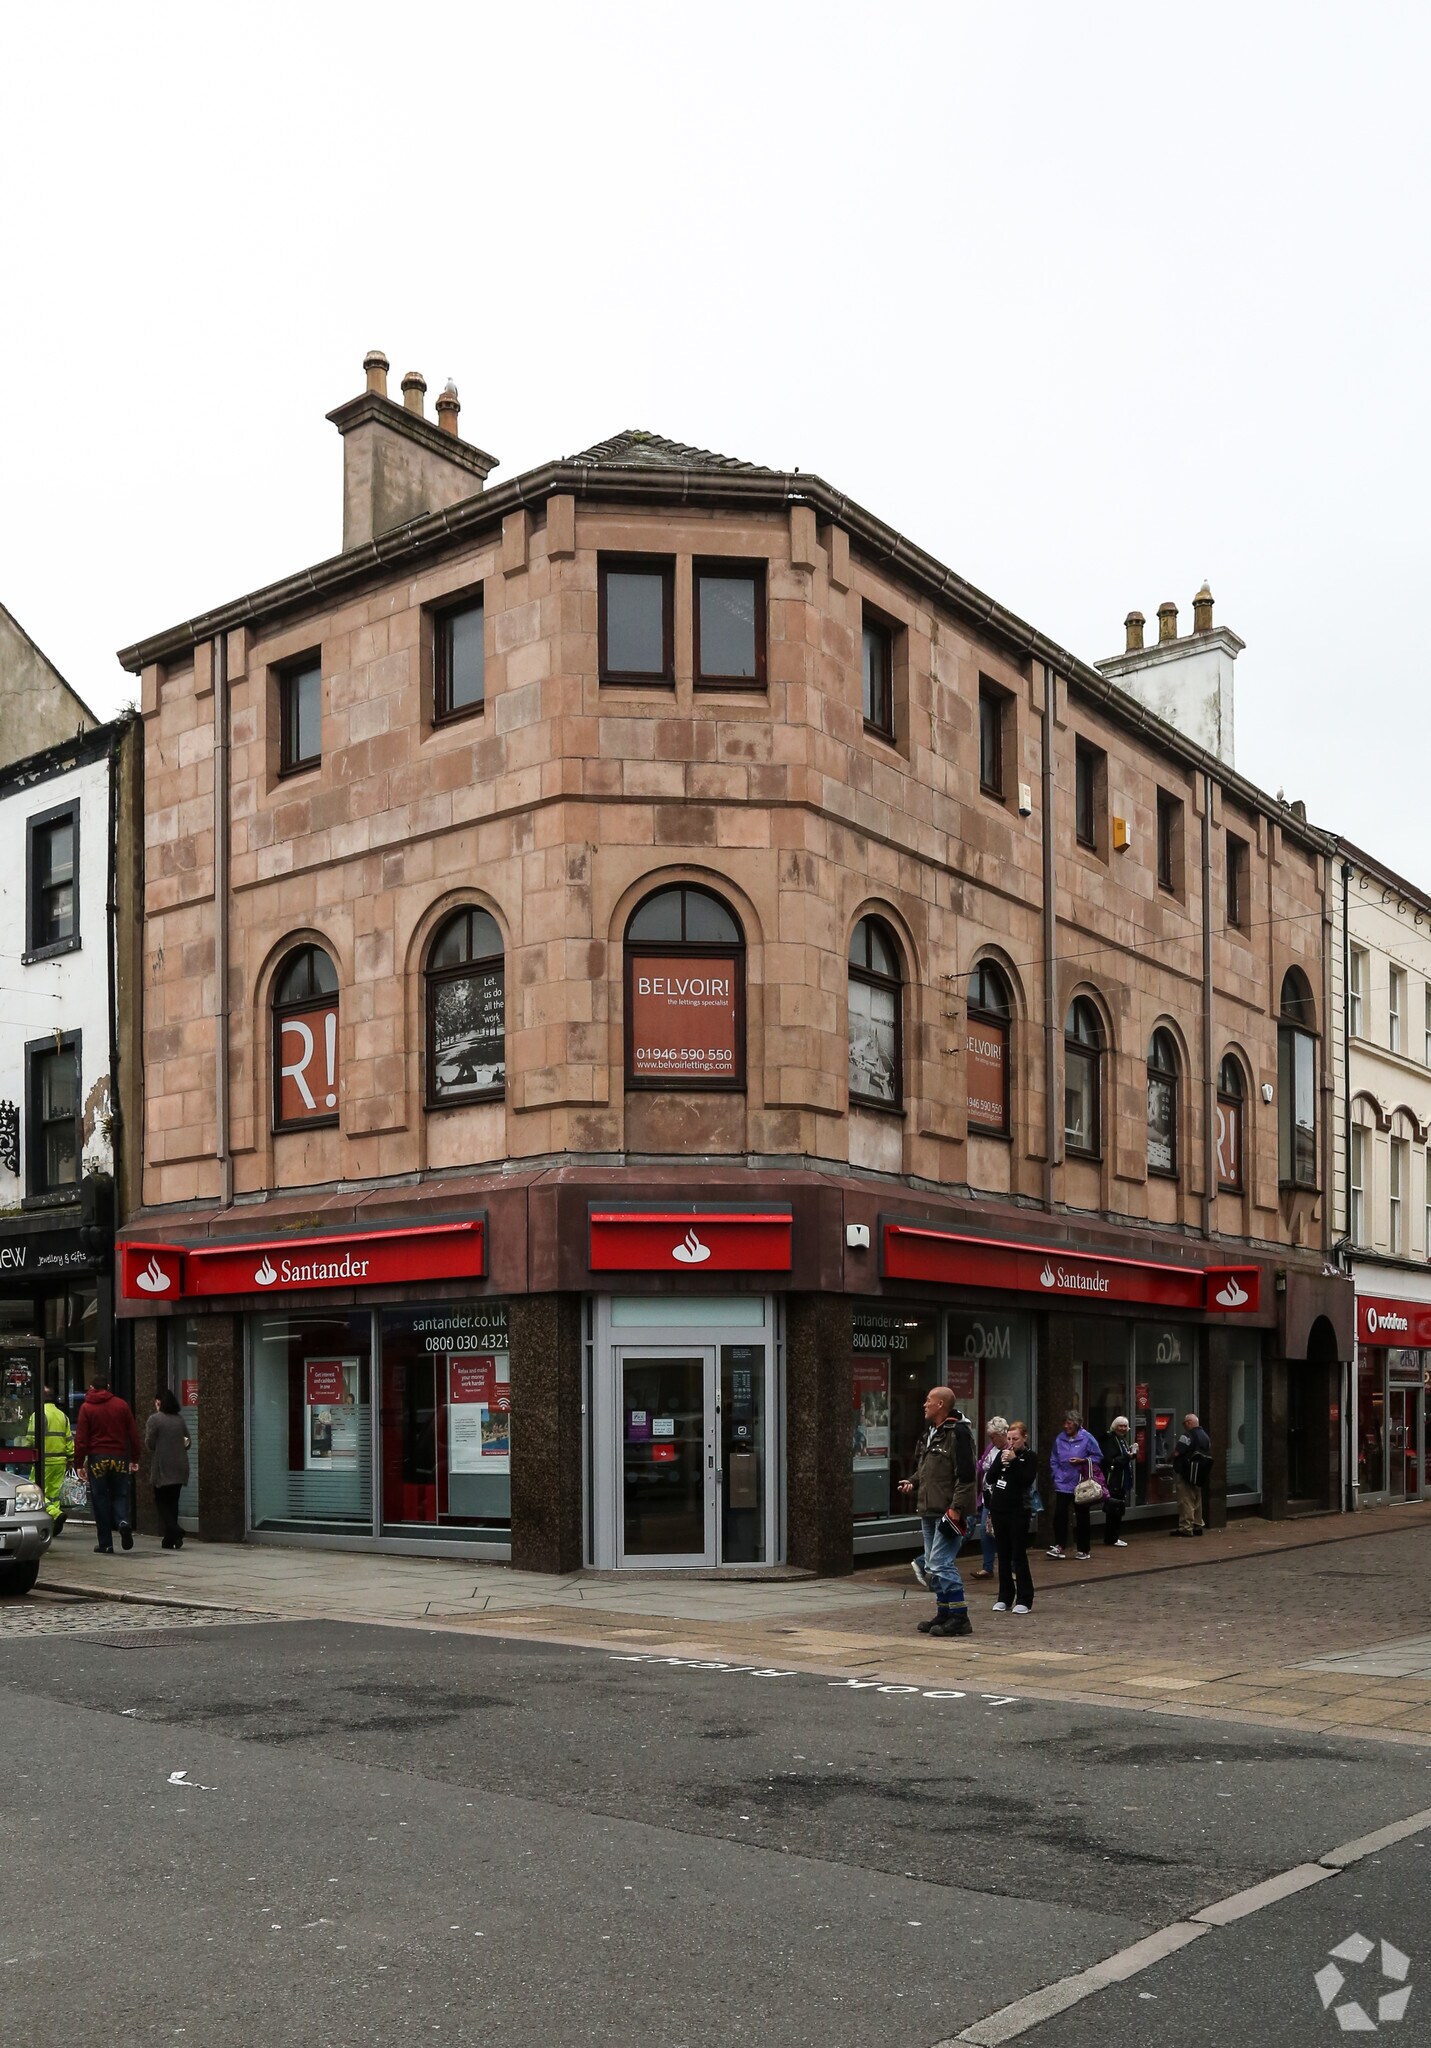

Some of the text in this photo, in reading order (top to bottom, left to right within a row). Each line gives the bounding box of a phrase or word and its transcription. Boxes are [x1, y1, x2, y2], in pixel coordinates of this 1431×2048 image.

[483, 987, 502, 999] us do
[638, 977, 729, 996] BELVOIR!
[493, 1000, 505, 1010] the
[667, 998, 729, 1007] the lettings specialist
[636, 1048, 733, 1061] 01946 590 550
[636, 1060, 733, 1071] www.belvoirlettings.com
[980, 1099, 991, 1111] 590
[991, 1102, 1002, 1115] 550
[0, 1246, 27, 1269] ew
[281, 1252, 369, 1283] Santander
[1057, 1266, 1110, 1292] Santander
[413, 1311, 508, 1331] santander.co.uk
[1377, 1312, 1408, 1331] vodafone
[425, 1336, 454, 1351] 0800
[456, 1335, 478, 1350] 030
[852, 1333, 908, 1349] 800 030 4321
[609, 1655, 1020, 1706] LOOK RIGHT
